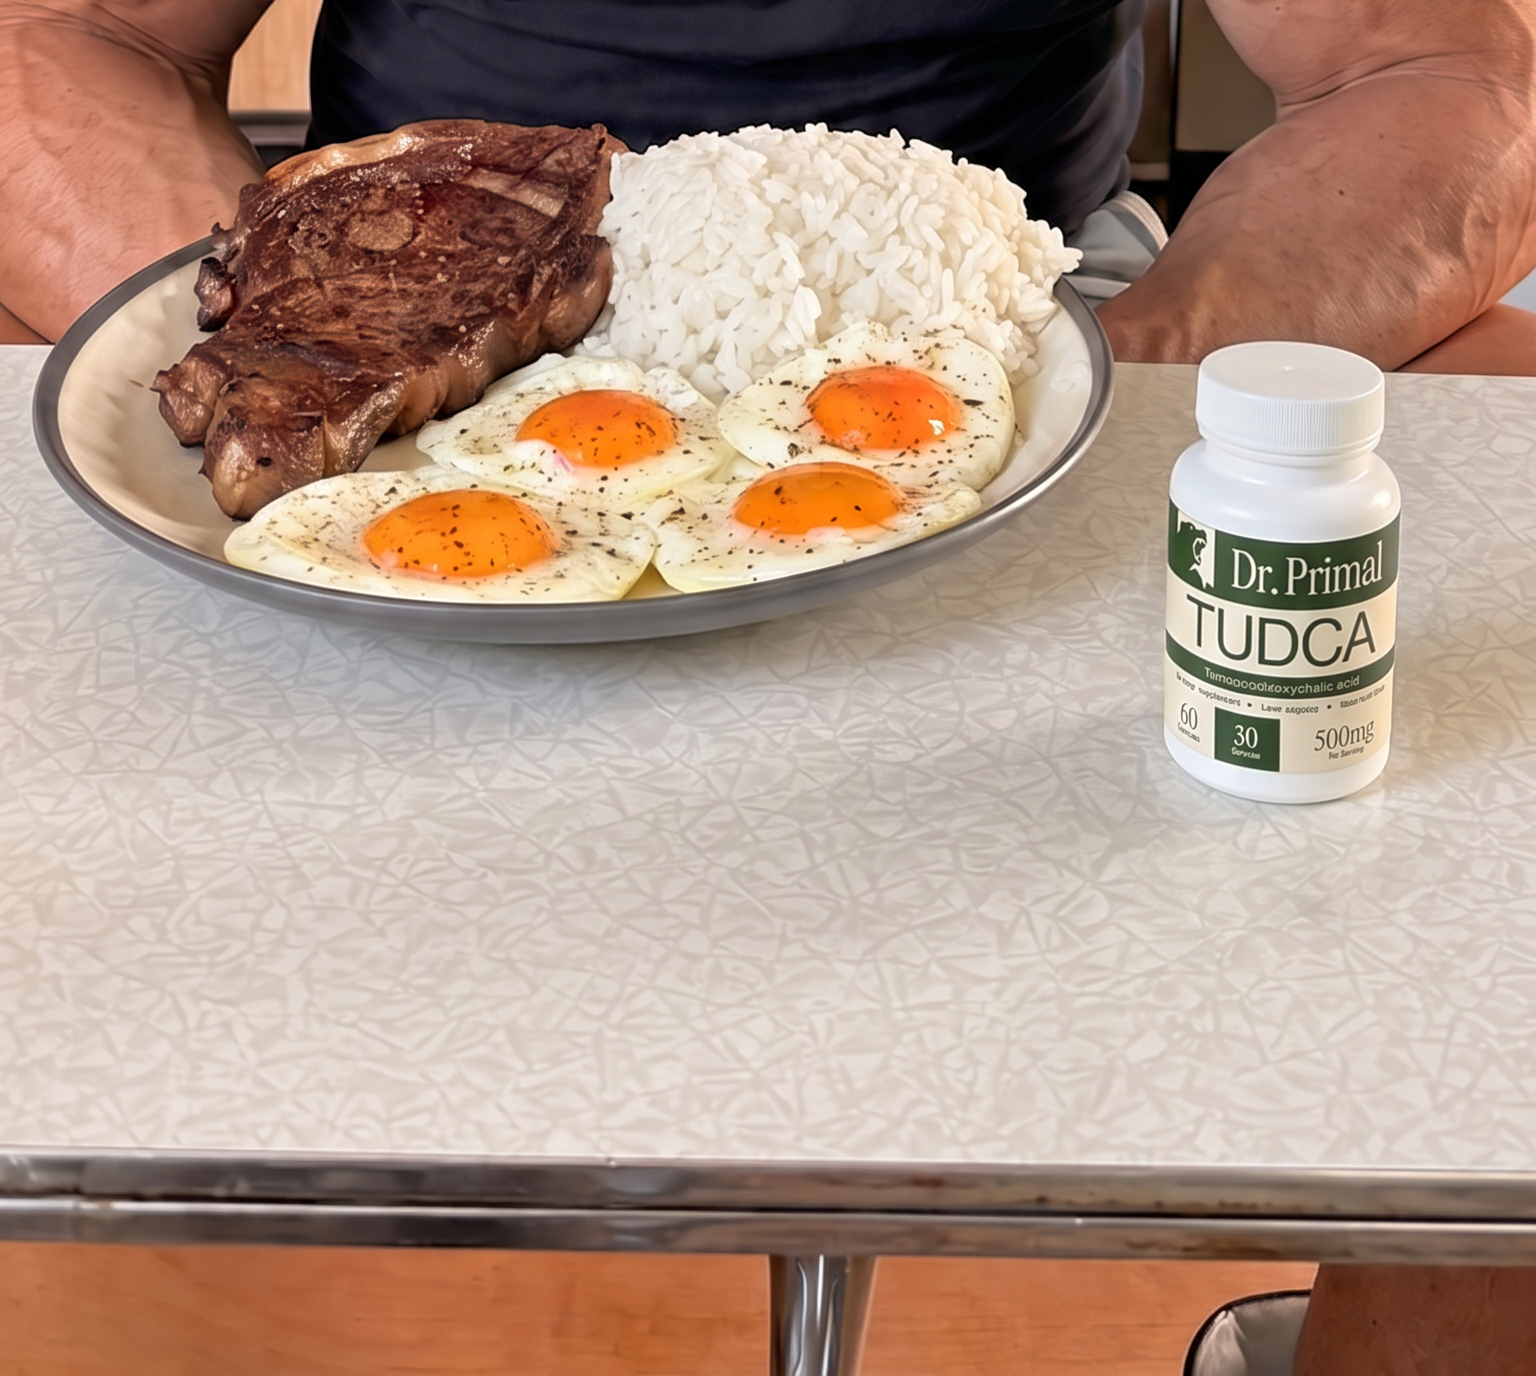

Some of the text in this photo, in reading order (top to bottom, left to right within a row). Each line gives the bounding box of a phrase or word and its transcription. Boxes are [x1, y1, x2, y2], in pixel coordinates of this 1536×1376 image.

[1231, 539, 1383, 596] Dr. Primal
[1186, 593, 1376, 667] TUDCA
[1336, 675, 1360, 690] acid
[1180, 703, 1198, 731] 60
[1233, 724, 1258, 749] 30
[1314, 720, 1375, 752] 500mg
